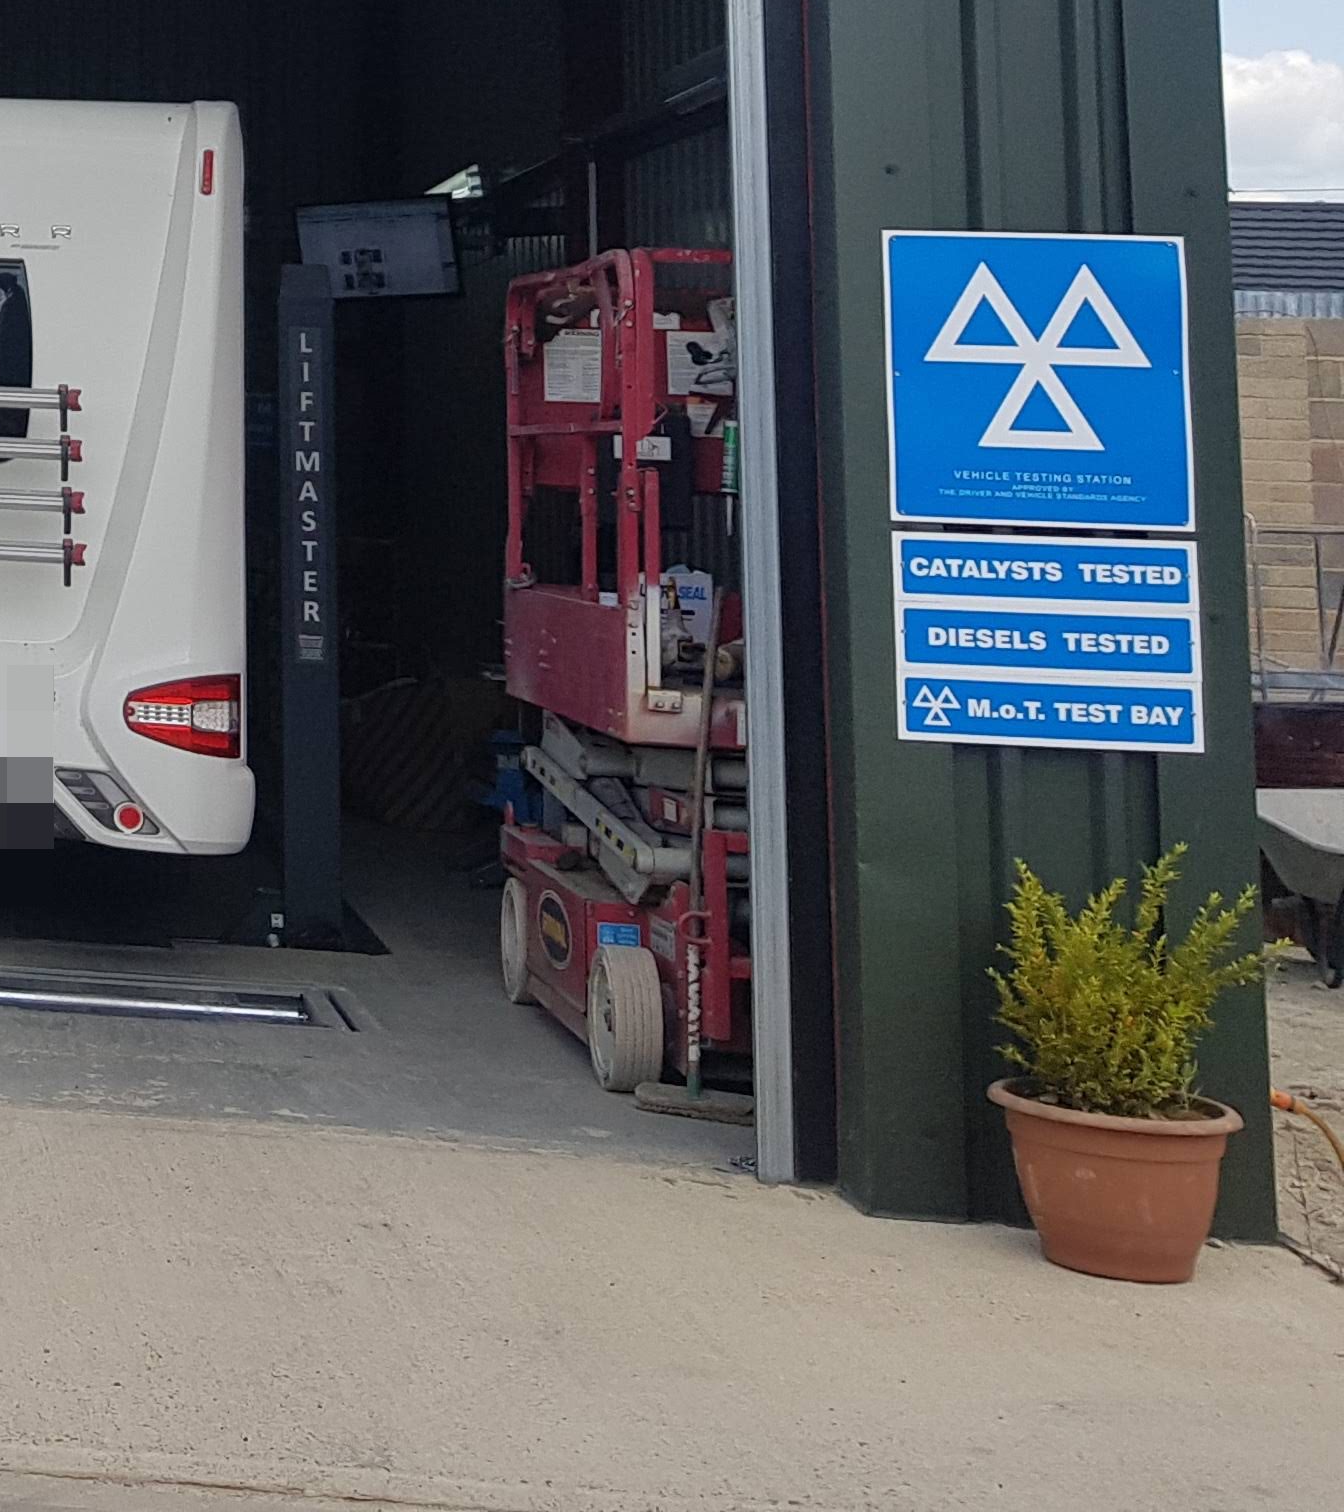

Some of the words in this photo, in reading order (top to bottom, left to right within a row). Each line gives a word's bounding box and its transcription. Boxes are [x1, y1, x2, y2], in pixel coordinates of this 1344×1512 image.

[295, 332, 321, 623] LIFTMASTER
[953, 470, 1011, 481] VEHICLE
[1015, 471, 1072, 483] TESTING
[1076, 473, 1133, 485] STATION
[909, 556, 1063, 582] CATALYSTS
[1078, 562, 1182, 586] TESTED
[927, 626, 1047, 651] DIESELS
[1062, 632, 1170, 656] TESTED
[967, 697, 1046, 721] M.o.T.
[1053, 701, 1123, 724] TEST
[1129, 705, 1184, 727] BAY
